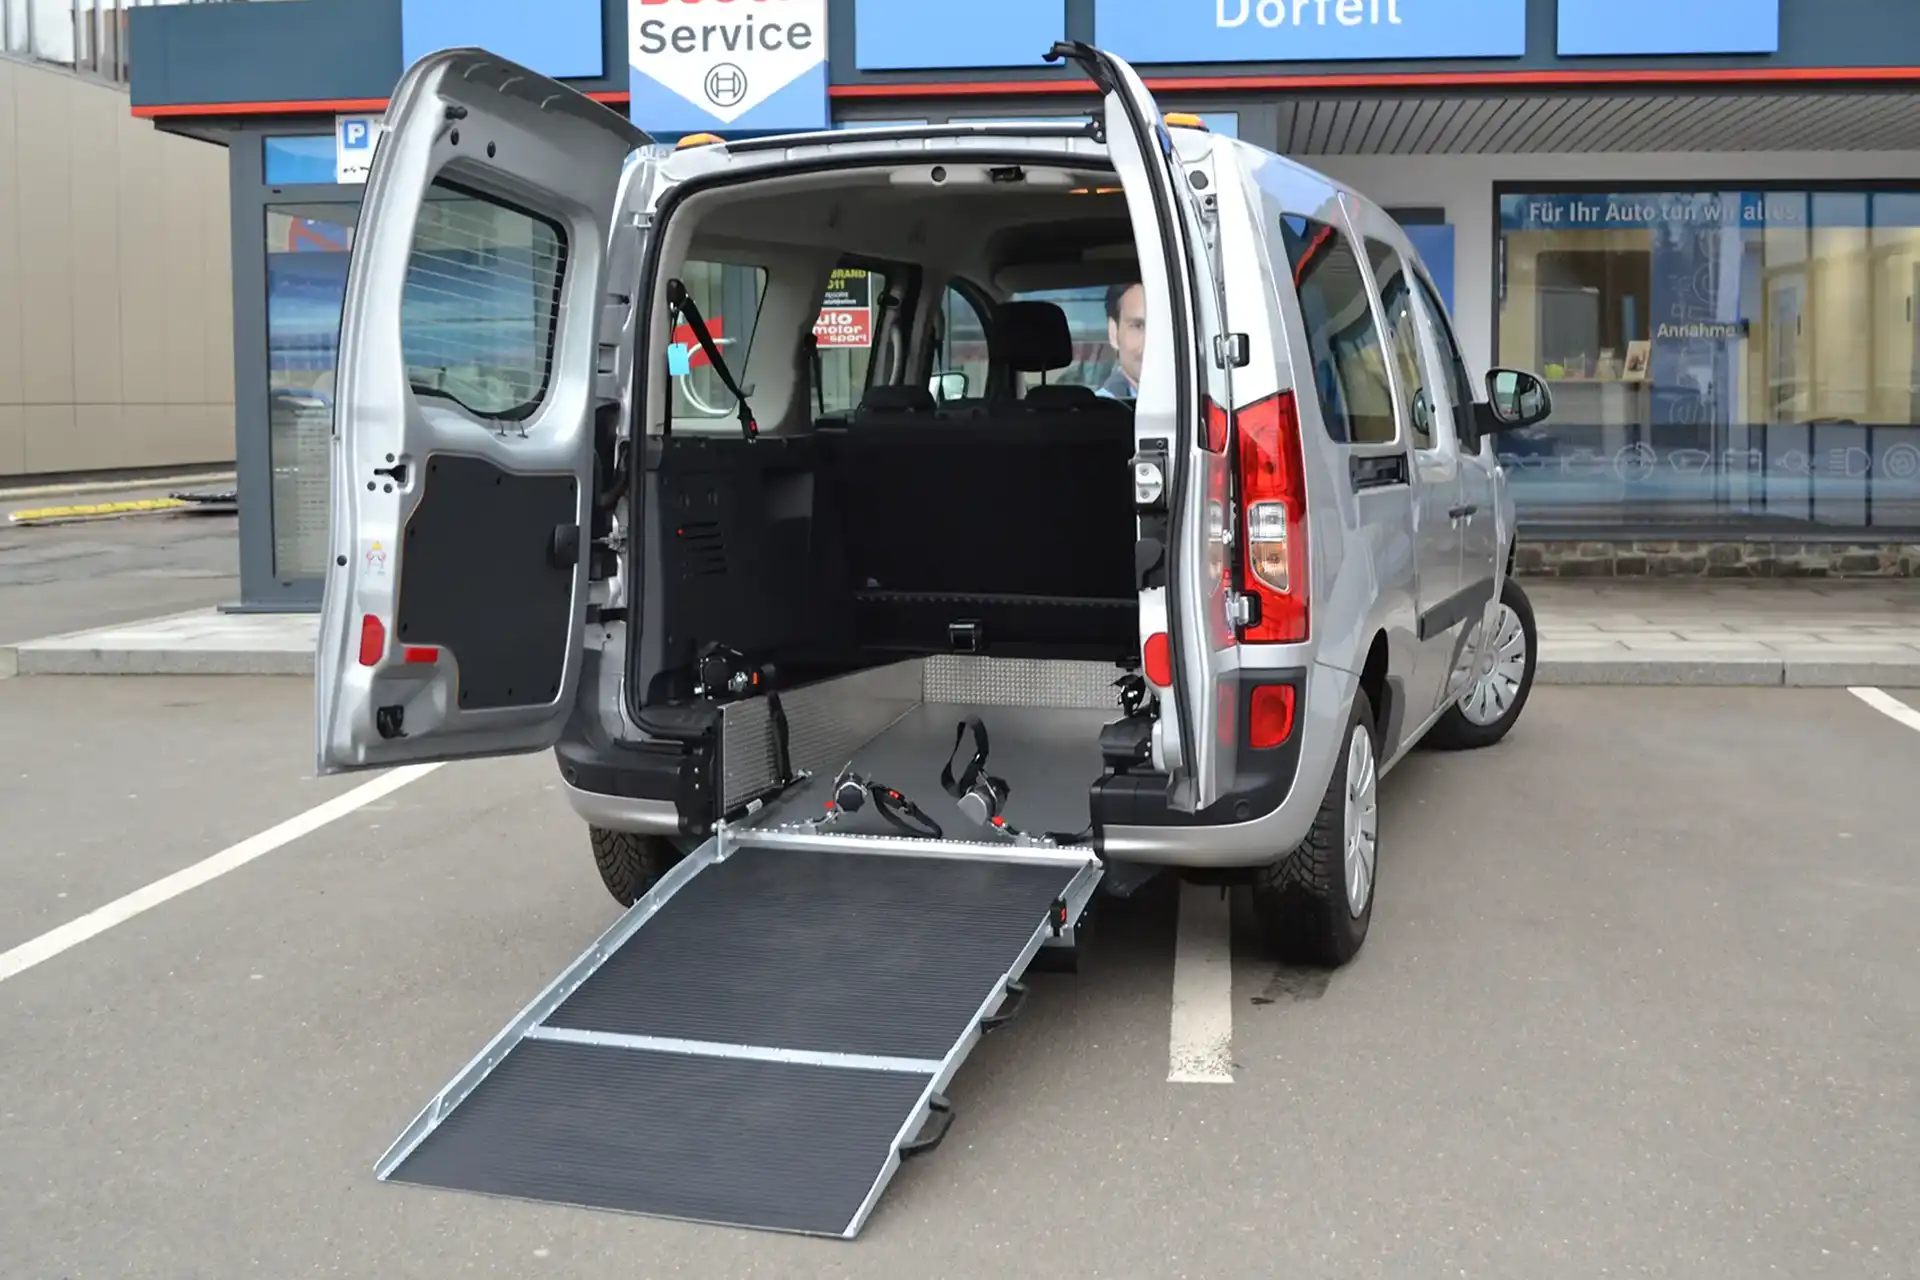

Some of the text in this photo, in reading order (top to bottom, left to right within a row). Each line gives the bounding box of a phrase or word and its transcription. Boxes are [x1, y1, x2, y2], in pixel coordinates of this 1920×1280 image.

[639, 14, 812, 54] Service
[347, 123, 365, 145] P
[1530, 201, 1563, 222] Für
[1569, 202, 1600, 221] Ihr
[1605, 202, 1656, 222] Auto
[1661, 202, 1697, 222] tun
[812, 325, 863, 335] motor
[1657, 322, 1736, 339] Annahme
